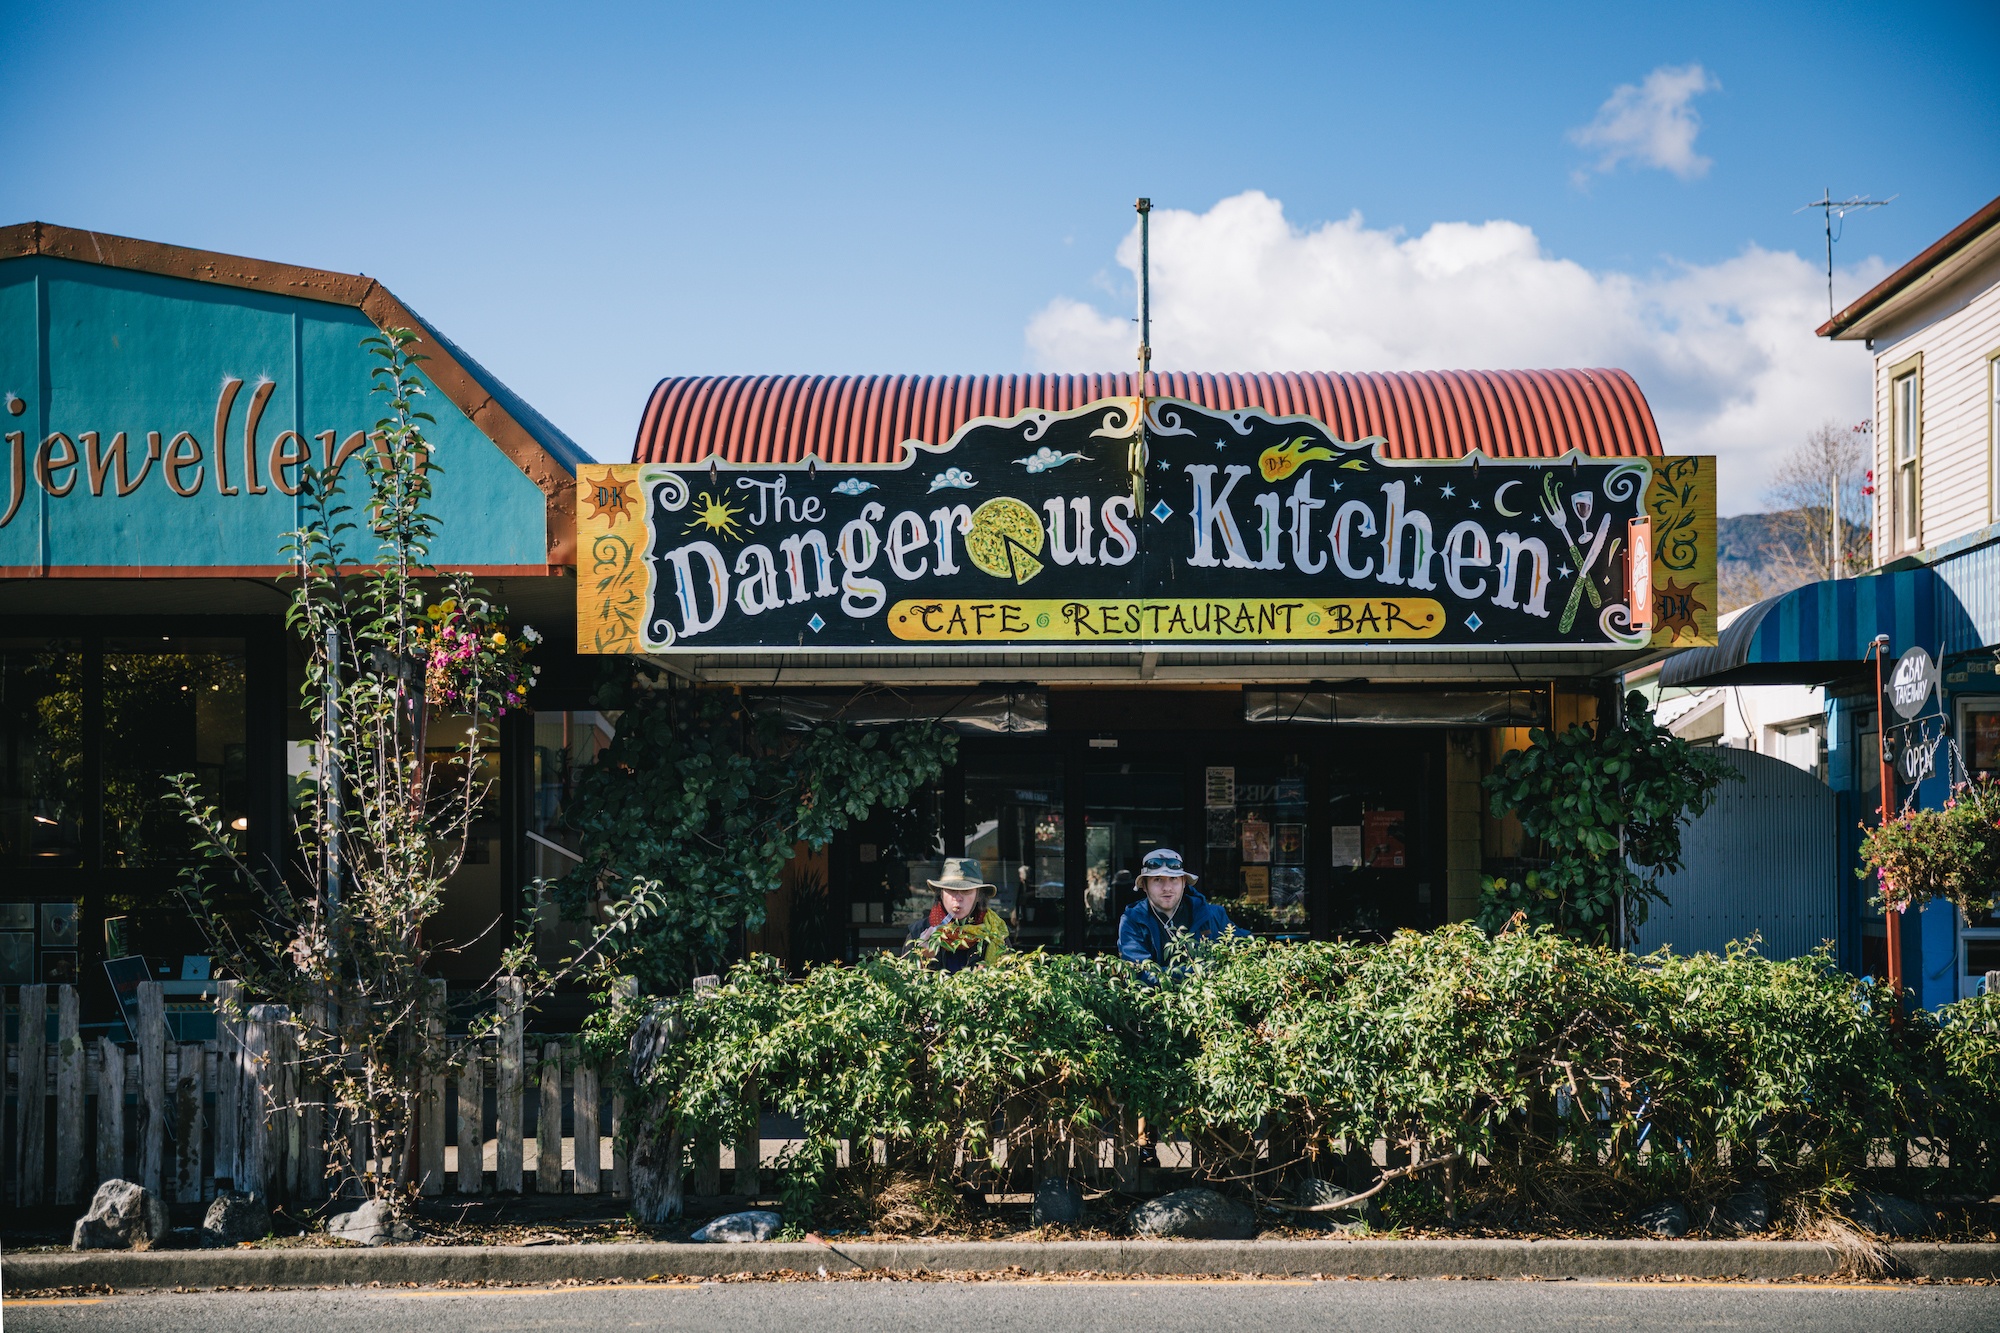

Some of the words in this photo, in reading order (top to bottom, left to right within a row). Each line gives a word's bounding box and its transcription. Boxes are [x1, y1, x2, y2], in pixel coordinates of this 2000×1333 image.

[0, 380, 429, 533] jewellery
[735, 473, 827, 526] The
[664, 495, 1138, 639] Dangerous
[1183, 462, 1551, 619] Kitchen
[910, 602, 1029, 637] CAFE
[1062, 600, 1304, 637] RESTAURANT
[1328, 601, 1432, 634] BAR
[1906, 744, 1933, 778] OPEN
